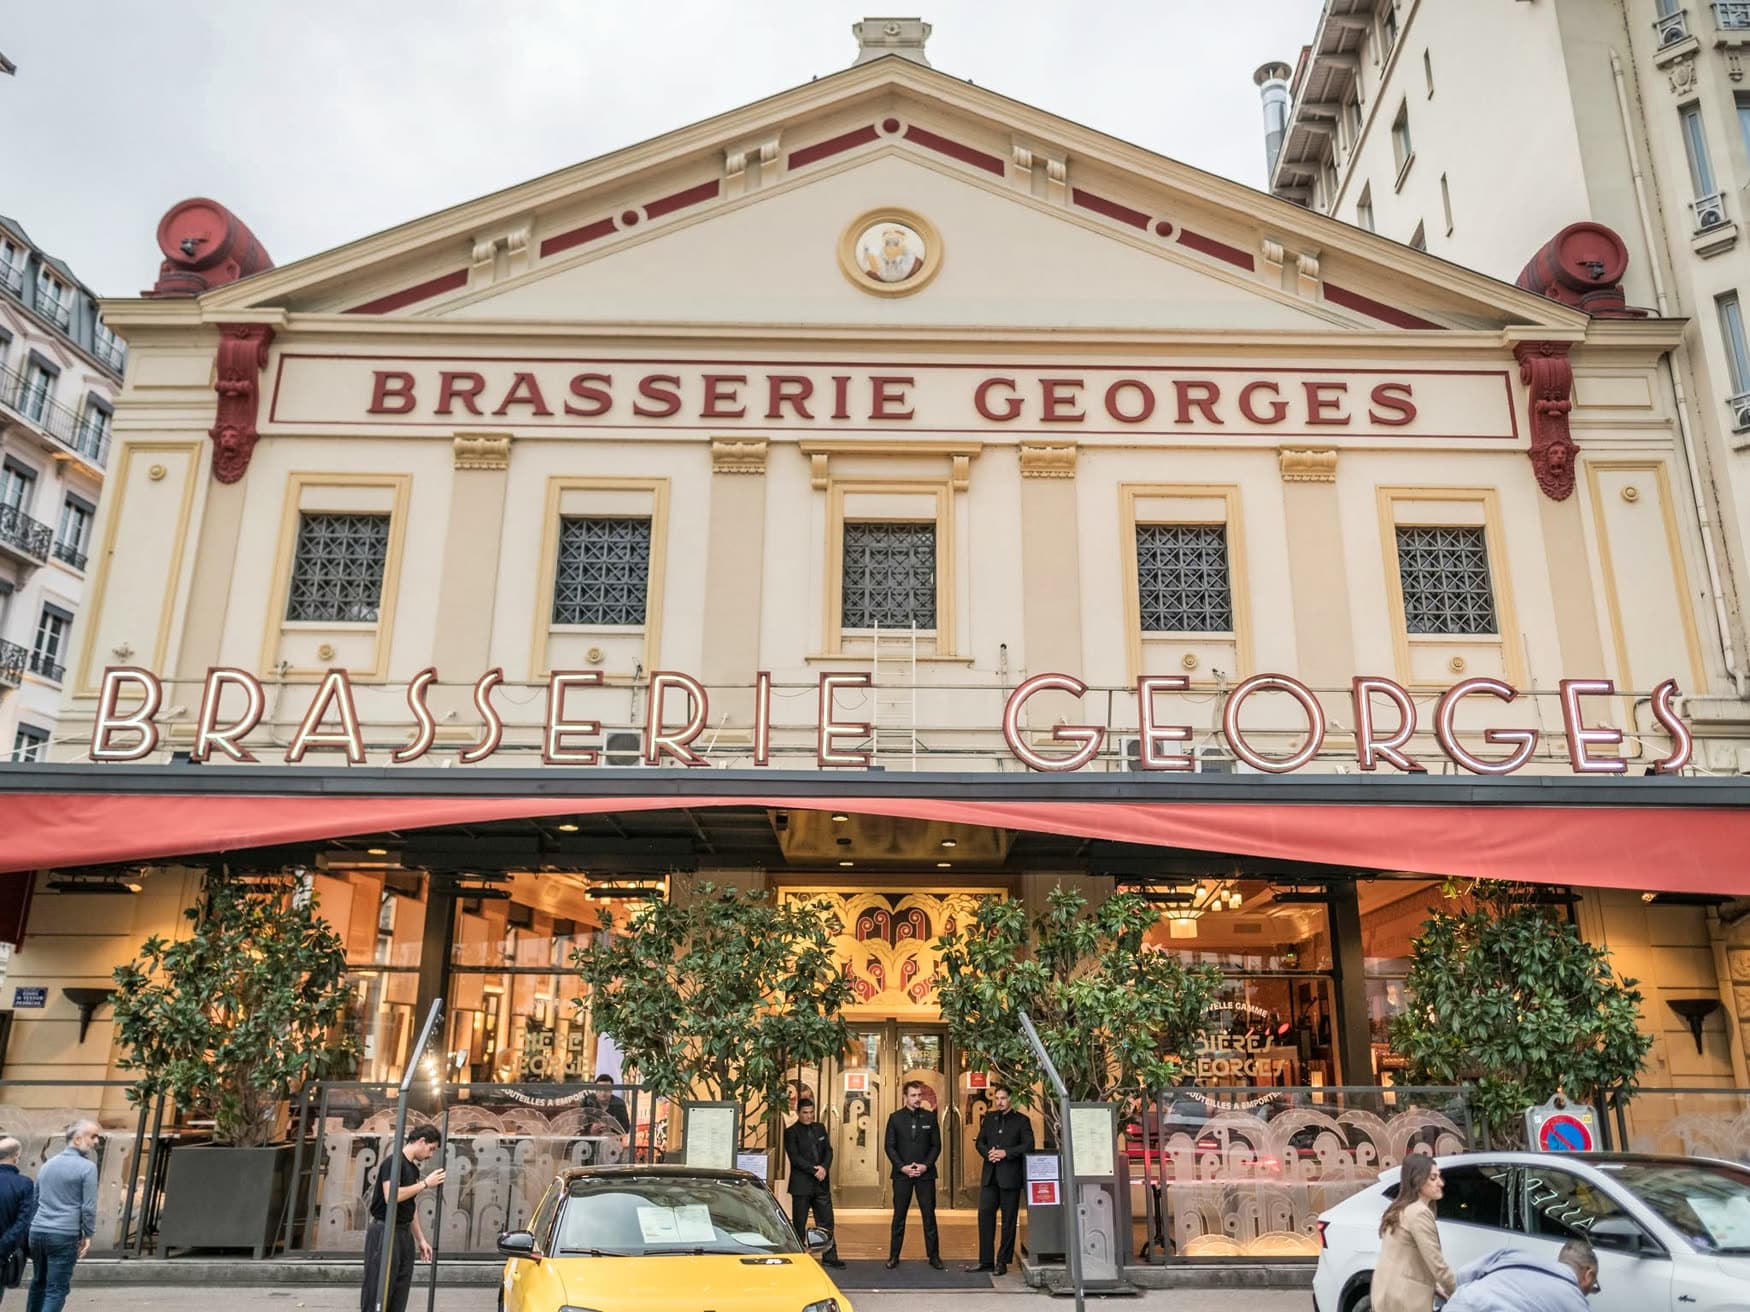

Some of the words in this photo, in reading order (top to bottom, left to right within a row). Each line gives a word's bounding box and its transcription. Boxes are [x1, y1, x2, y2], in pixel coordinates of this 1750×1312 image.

[369, 369, 914, 421] BRASSERIE
[973, 377, 1418, 428] GEORGES
[89, 666, 871, 767] BRASSERIE
[1002, 672, 1693, 773] GEORGES
[1235, 1002, 1268, 1018] GAMME
[1181, 1057, 1286, 1077] GEORGES
[501, 1088, 545, 1106] OUTEILLES
[1186, 1092, 1232, 1110] OUTEILLES
